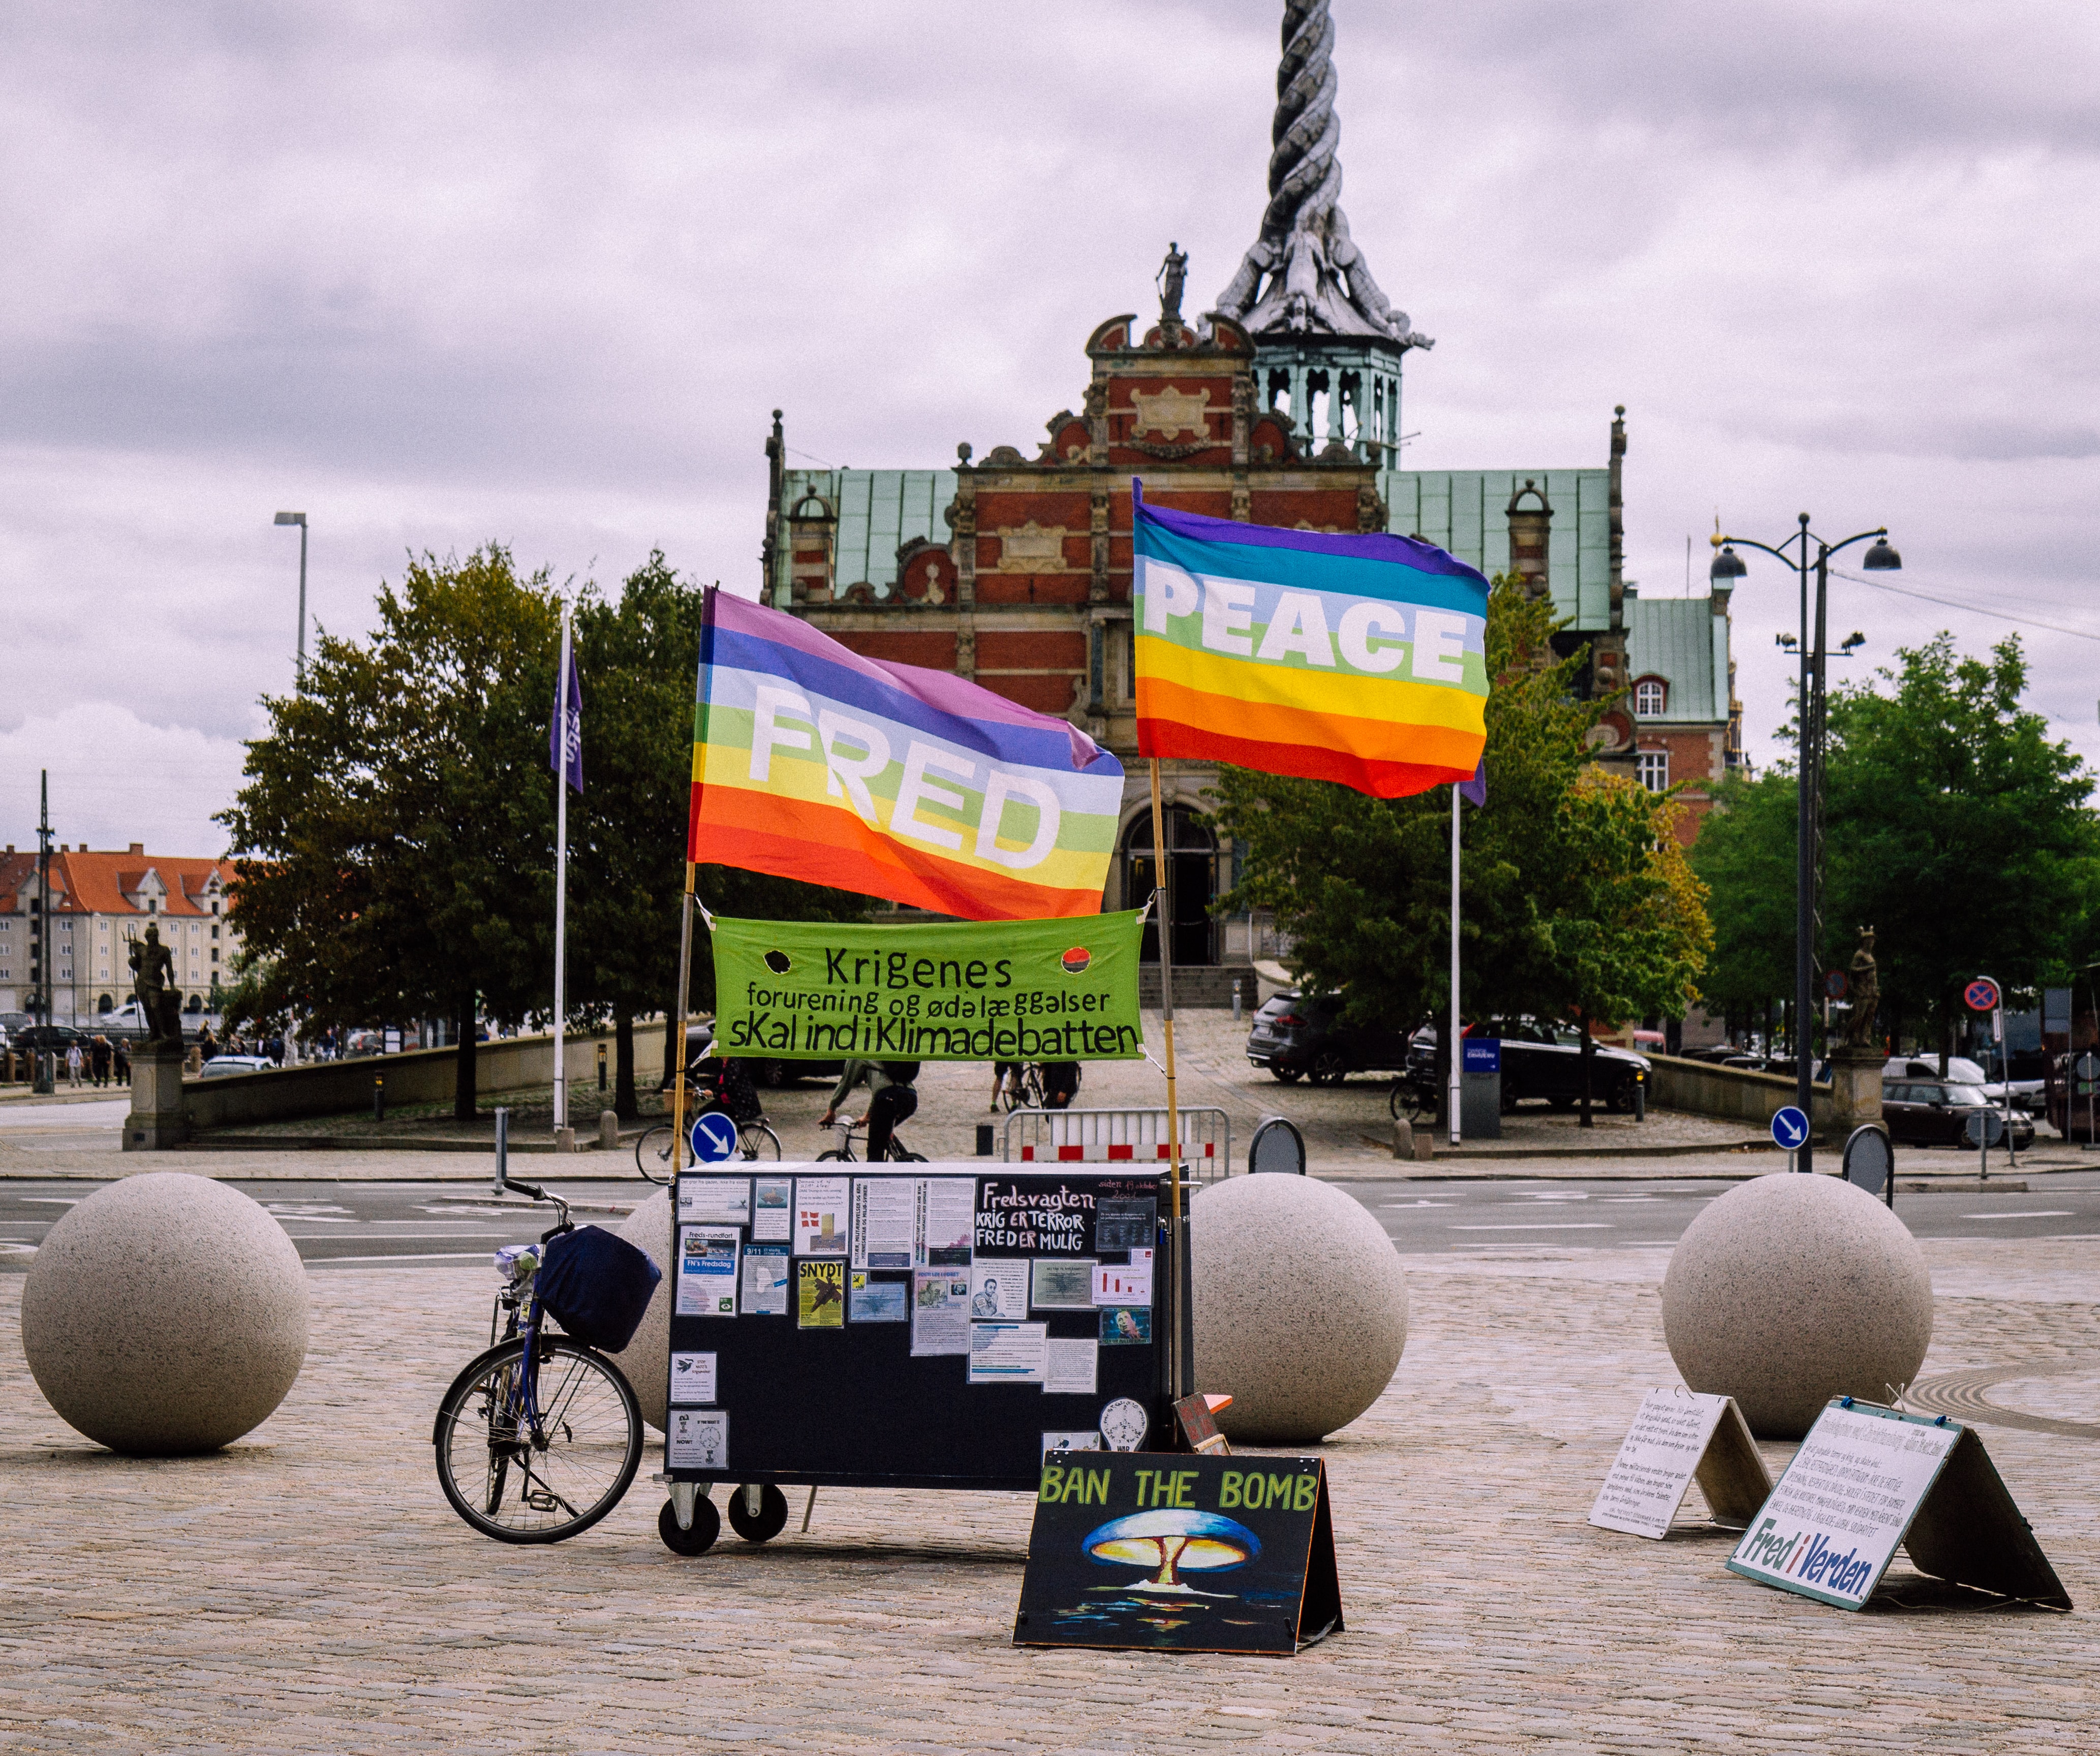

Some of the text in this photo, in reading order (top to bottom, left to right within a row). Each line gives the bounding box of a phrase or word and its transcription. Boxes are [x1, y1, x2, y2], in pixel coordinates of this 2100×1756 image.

[1143, 561, 1468, 684] PEACE
[749, 684, 1061, 868] FRED
[825, 948, 1011, 989] Krigenes
[747, 981, 879, 1014] forurening
[889, 994, 920, 1017] og
[805, 1015, 858, 1051] ind
[863, 1017, 872, 1052] i
[875, 1016, 1139, 1057] Klimadebatten
[983, 1181, 1096, 1213] Fredsvagten
[1098, 1179, 1122, 1188] siden
[976, 1228, 1017, 1247] FRED
[1018, 1230, 1037, 1248] ER
[1010, 1211, 1028, 1229] ER
[701, 1260, 731, 1268] Fredsdag
[800, 1263, 843, 1277] SNYDT
[1039, 1464, 1319, 1511] BAN THE BOMB
[1742, 1518, 1872, 1595] Fred i Verden
